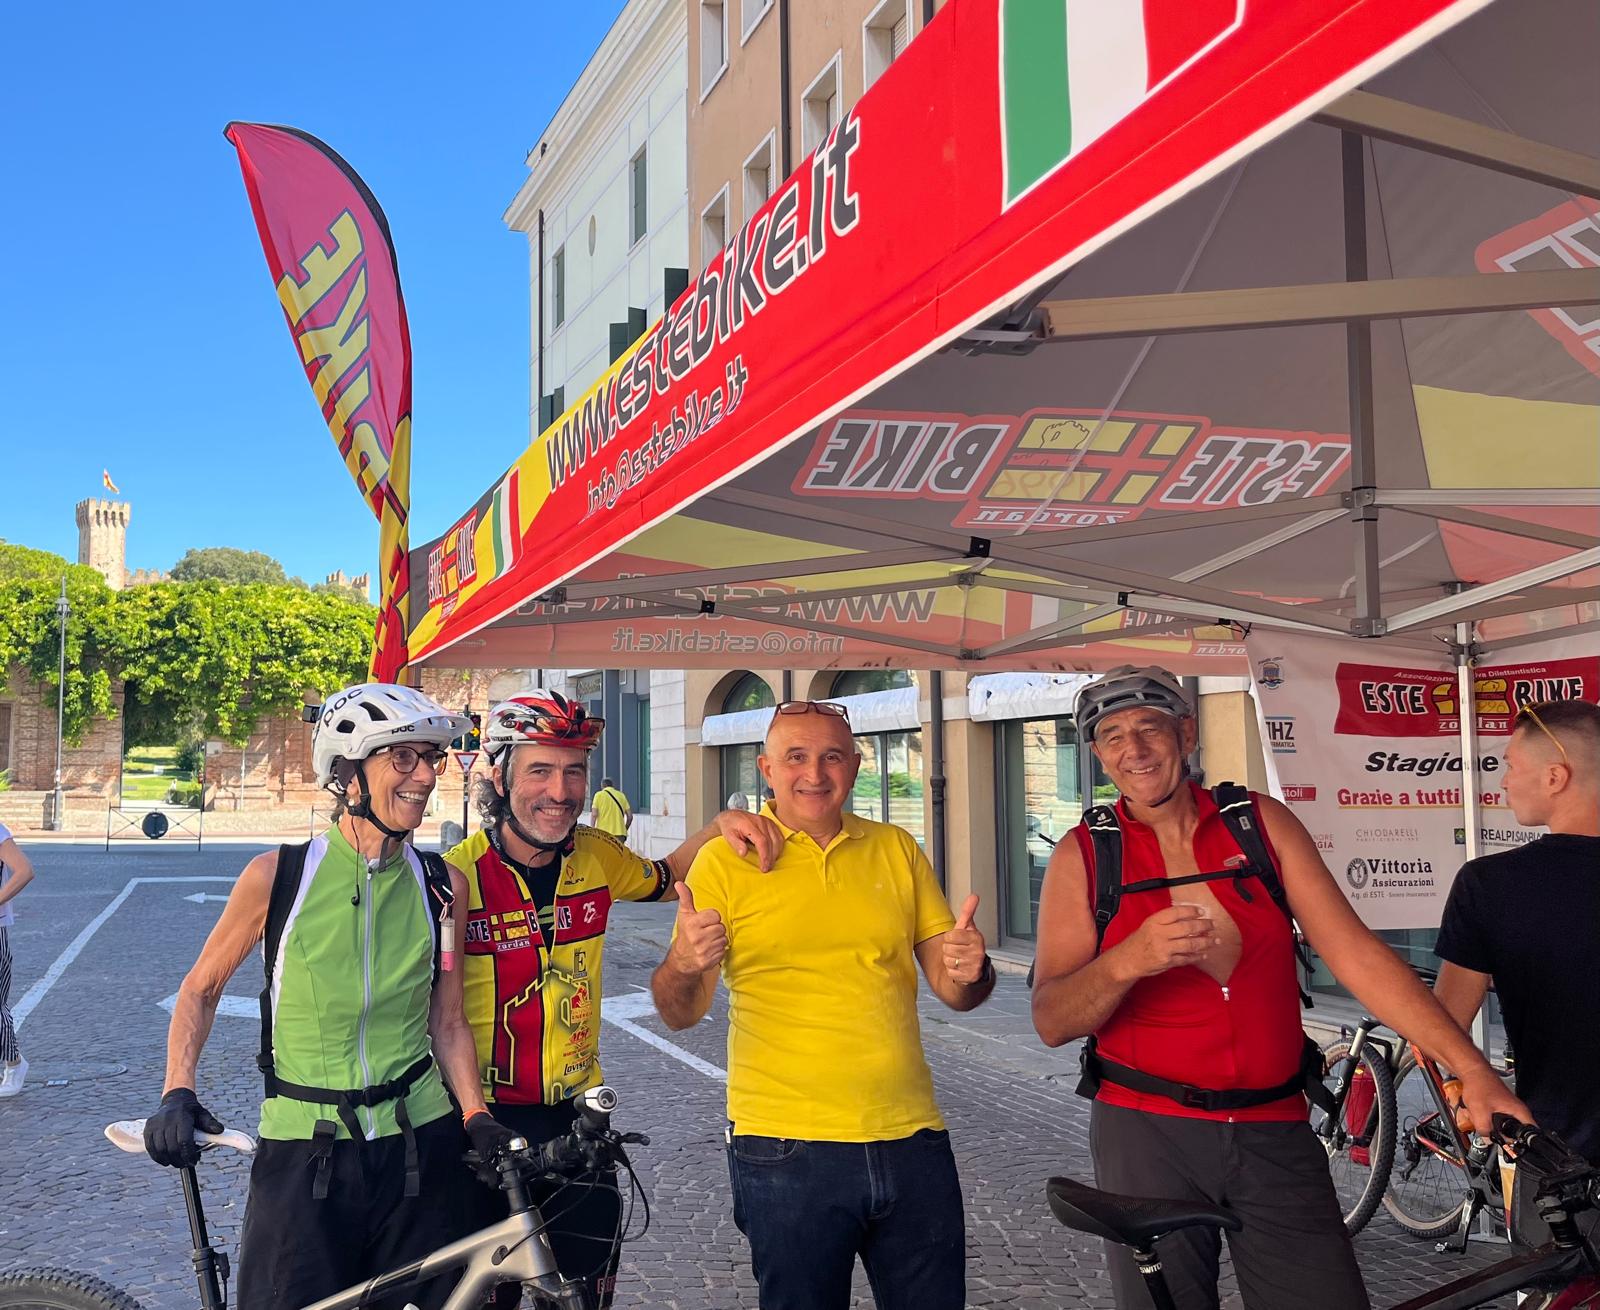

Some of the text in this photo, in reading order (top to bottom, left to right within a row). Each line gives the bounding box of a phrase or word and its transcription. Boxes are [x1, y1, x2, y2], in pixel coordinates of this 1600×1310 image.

[546, 110, 861, 495] www.estebike.it
[587, 354, 749, 512] info@estebike.it
[1359, 681, 1429, 715] ESTE
[1365, 751, 1499, 777] Stagioe
[1337, 788, 1393, 806] Grazie
[1399, 793, 1410, 805] a
[1416, 788, 1460, 805] tutti
[1367, 858, 1432, 874] Vittoria
[1372, 878, 1434, 888] Assicurazioni
[464, 919, 490, 942] STE
